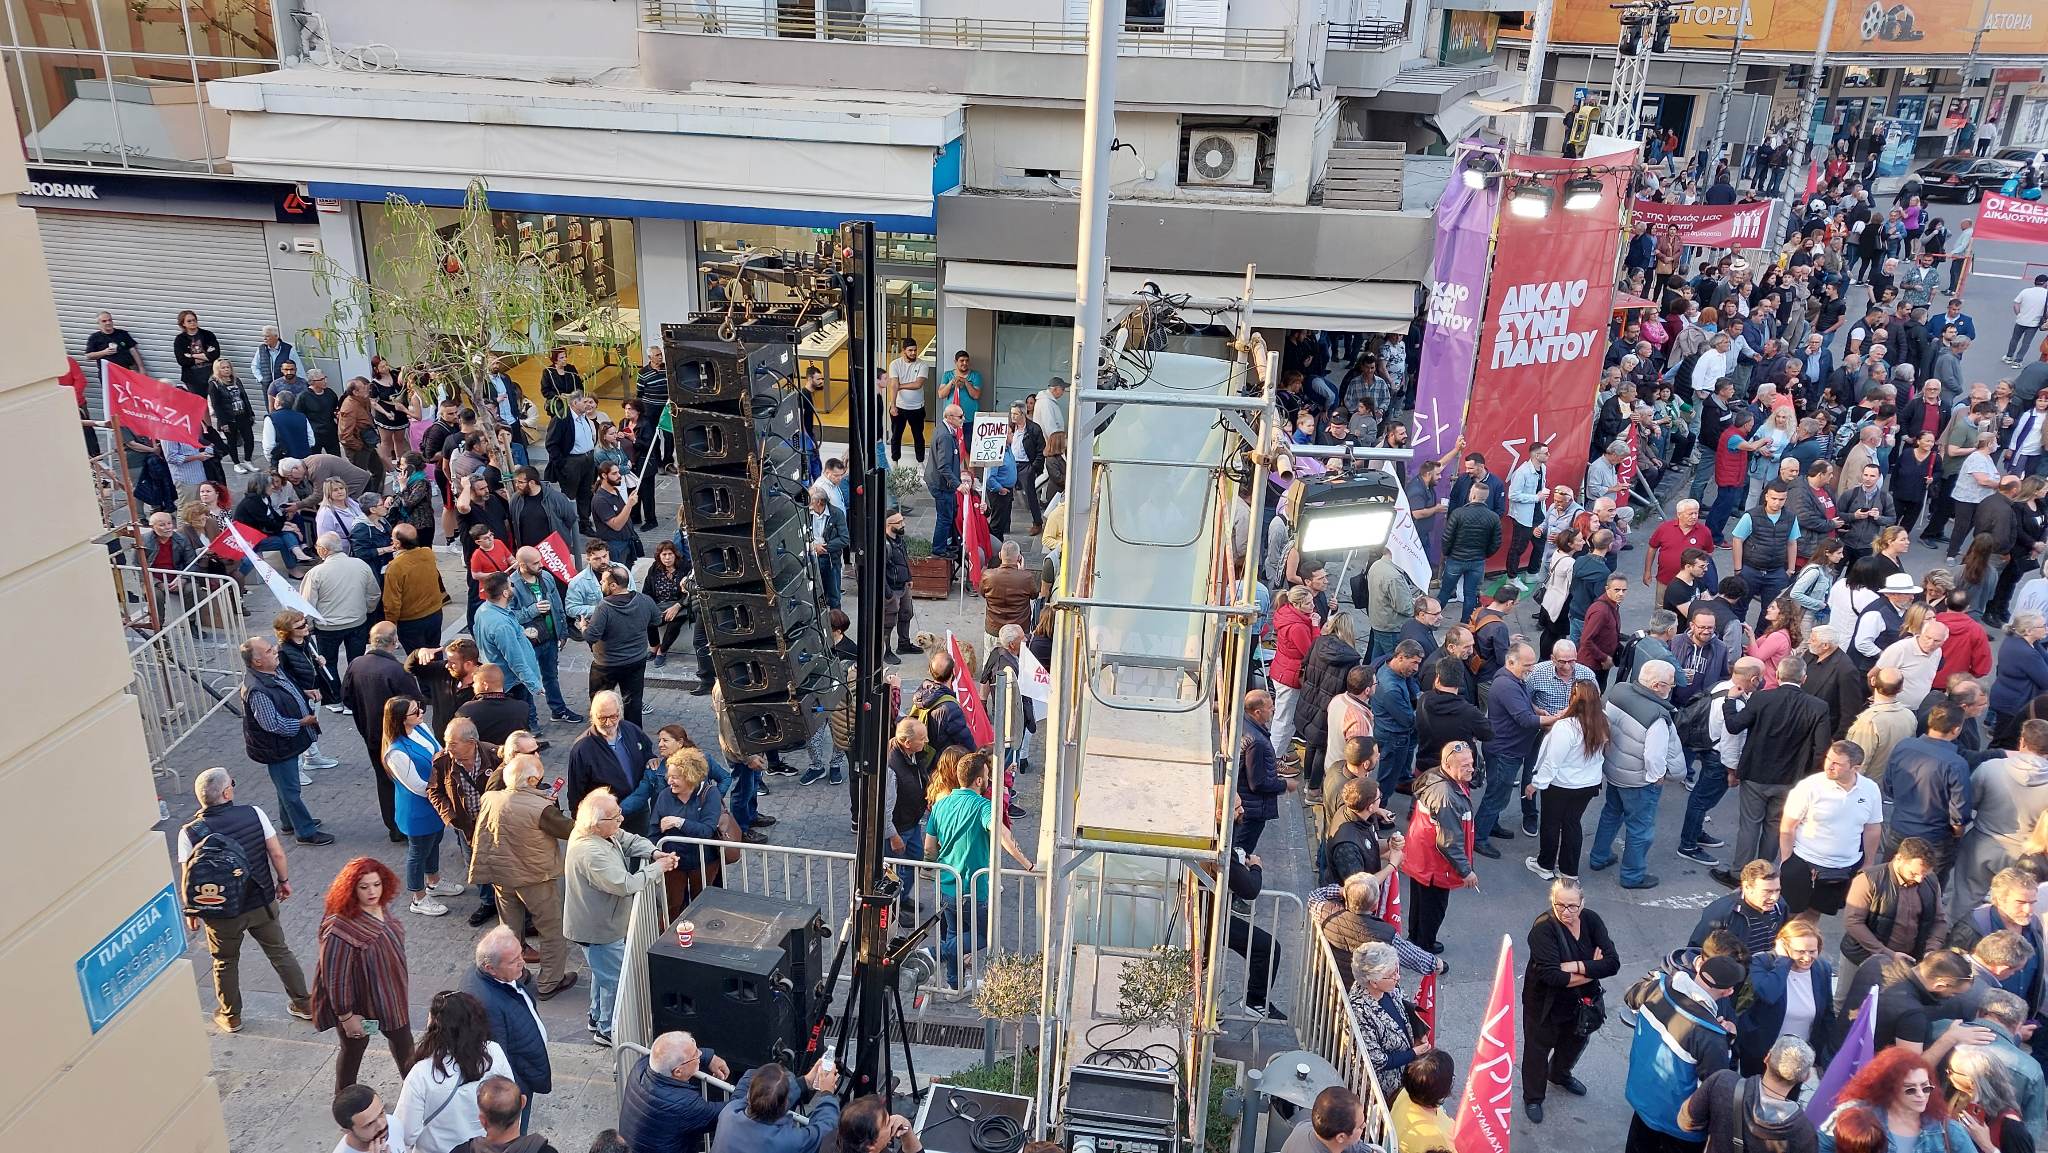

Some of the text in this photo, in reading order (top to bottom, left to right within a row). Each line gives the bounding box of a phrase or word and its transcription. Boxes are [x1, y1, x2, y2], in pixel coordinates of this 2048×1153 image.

[1984, 13, 2033, 30] ΑΣΤΟΡΙΑ
[1986, 198, 2005, 211] ΟΙ
[1647, 212, 1664, 222] της
[1667, 213, 1700, 223] γενιάς
[1701, 214, 1722, 222] μας
[1983, 210, 2048, 225] ΔΙΚΑΙΟΣΥΝΗ
[1499, 279, 1588, 316] ΔΙΚΑΙΟ
[1495, 307, 1570, 343] ΣΥΝΗ
[1490, 329, 1598, 370] ΠΑΝΤΟΥ
[977, 421, 1008, 440] ΦΤΑΝΕΙ
[98, 906, 162, 967] ΠΛΑΤΕΙΑ
